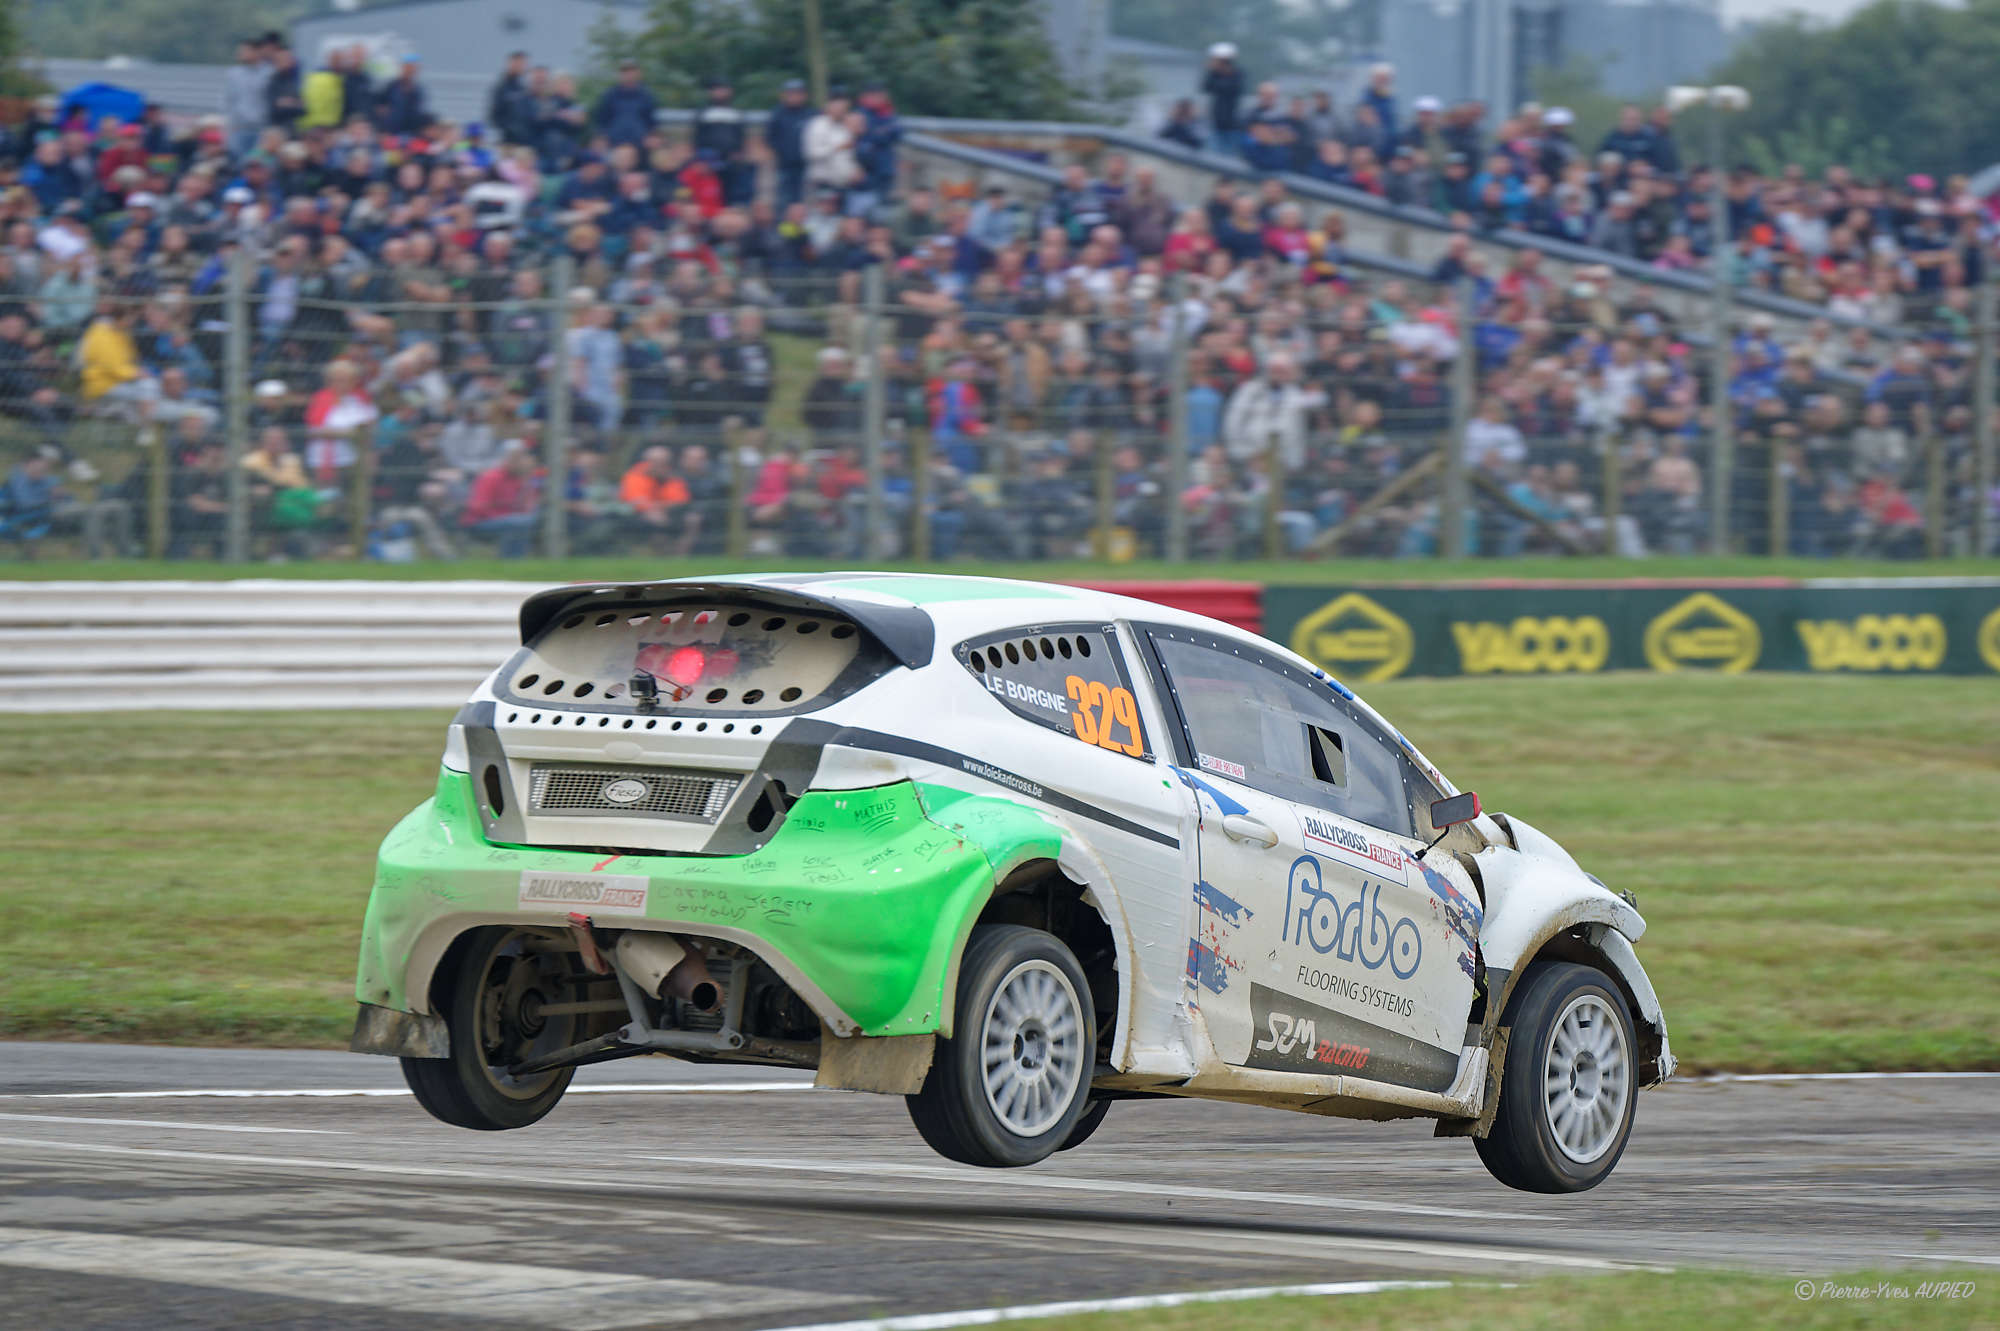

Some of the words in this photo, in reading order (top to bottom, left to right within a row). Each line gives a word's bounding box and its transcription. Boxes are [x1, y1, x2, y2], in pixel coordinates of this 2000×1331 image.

[1453, 617, 1609, 673] YACCO
[1796, 614, 1947, 670] YACCO
[984, 673, 1005, 696] LE
[1005, 679, 1068, 714] BORGNE
[1065, 675, 1144, 757] 329
[1304, 816, 1368, 853] RALLYCROSS
[1371, 845, 1402, 870] FRANCE
[526, 878, 605, 901] RALLYCROSS
[604, 890, 642, 906] FRANCE
[1282, 855, 1422, 980] forbo
[1297, 965, 1358, 1001] FLOORING
[1360, 985, 1414, 1018] SYSTEMS
